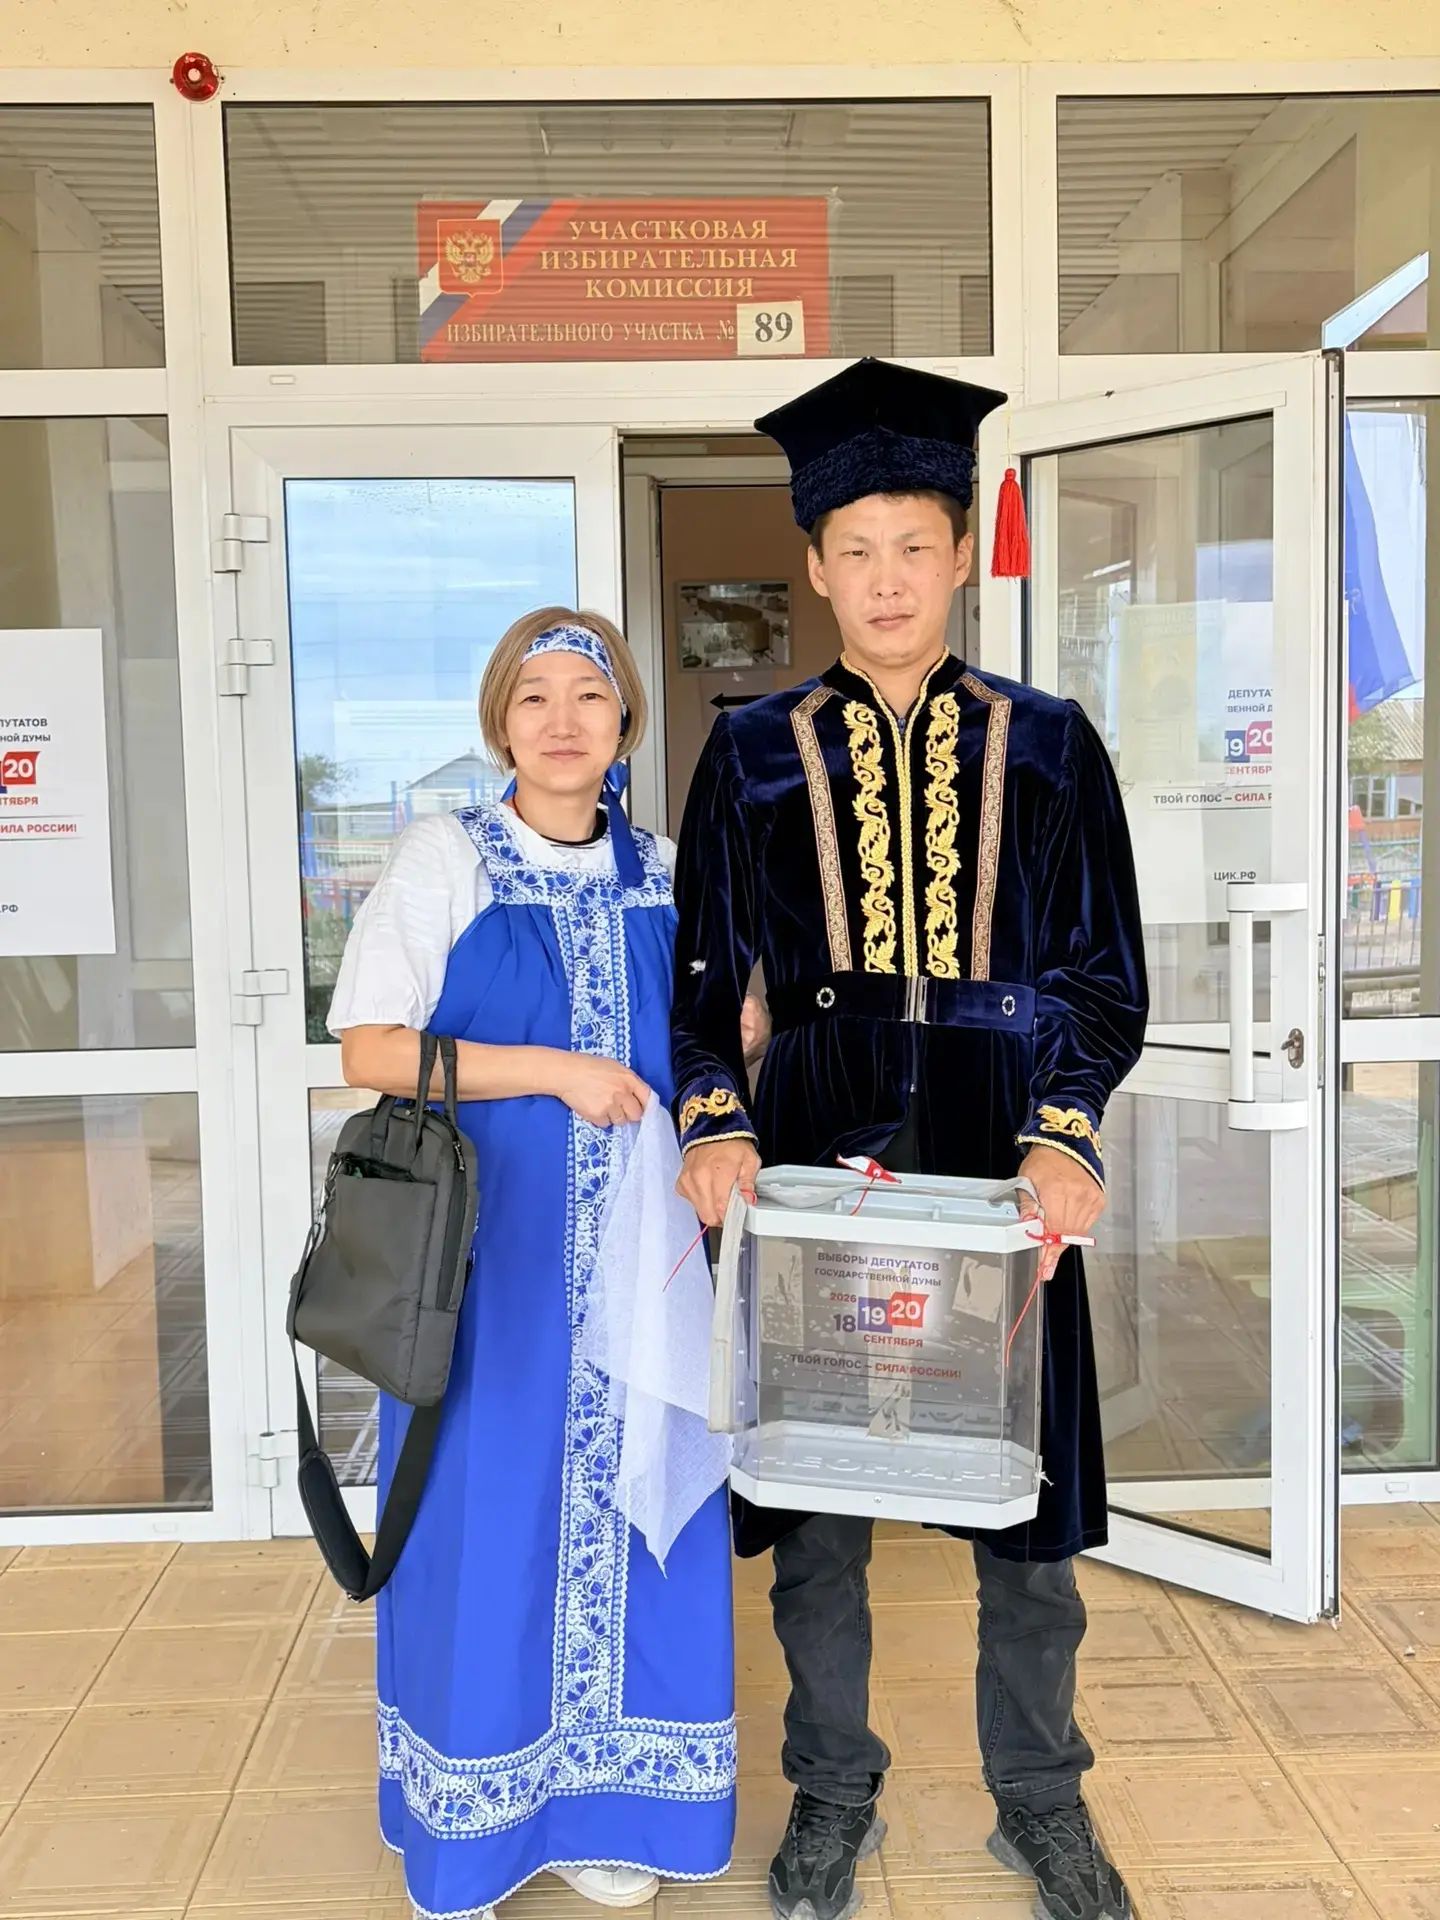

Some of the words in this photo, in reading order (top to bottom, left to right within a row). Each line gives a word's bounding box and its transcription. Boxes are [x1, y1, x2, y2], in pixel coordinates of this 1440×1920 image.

[568, 220, 768, 241] УЧАСТКОВАЯ
[540, 248, 798, 270] ИЗБИРАТЕЛЬНАЯ
[585, 278, 755, 298] КОМИССИЯ
[447, 323, 614, 343] ИЗБИРАТЕЛЬНОГО
[623, 322, 705, 342] УЧАСТКА
[716, 319, 736, 341] №
[754, 311, 793, 343] 89
[1228, 688, 1273, 699] ДЕПУТА
[22, 734, 51, 743] ДУМЫ
[4, 758, 33, 778] 20
[1153, 793, 1183, 804] ТВОЙ
[1186, 794, 1222, 803] ГОЛОС
[1234, 793, 1265, 802] СИЛА
[27, 823, 77, 833] РОССИИ!
[1213, 871, 1256, 881] ЦИК.РФ
[817, 1252, 868, 1265] ВЫБОРЫ
[870, 1257, 940, 1272] ДЕПУТАТОВ
[814, 1267, 910, 1284] ГОСУДАРСТВЕННОЙ
[911, 1277, 942, 1288] ДУМЫ
[830, 1292, 857, 1303] 2026
[833, 1313, 856, 1333] 18
[861, 1305, 886, 1325] 19
[891, 1300, 921, 1320] 20
[863, 1334, 923, 1348] СЕНТЯБРЯ
[791, 1353, 822, 1366] ТВОЙ
[823, 1356, 862, 1370] ГОЛОС
[875, 1362, 908, 1375] СИЛА
[909, 1366, 961, 1379] РОССИИ!
